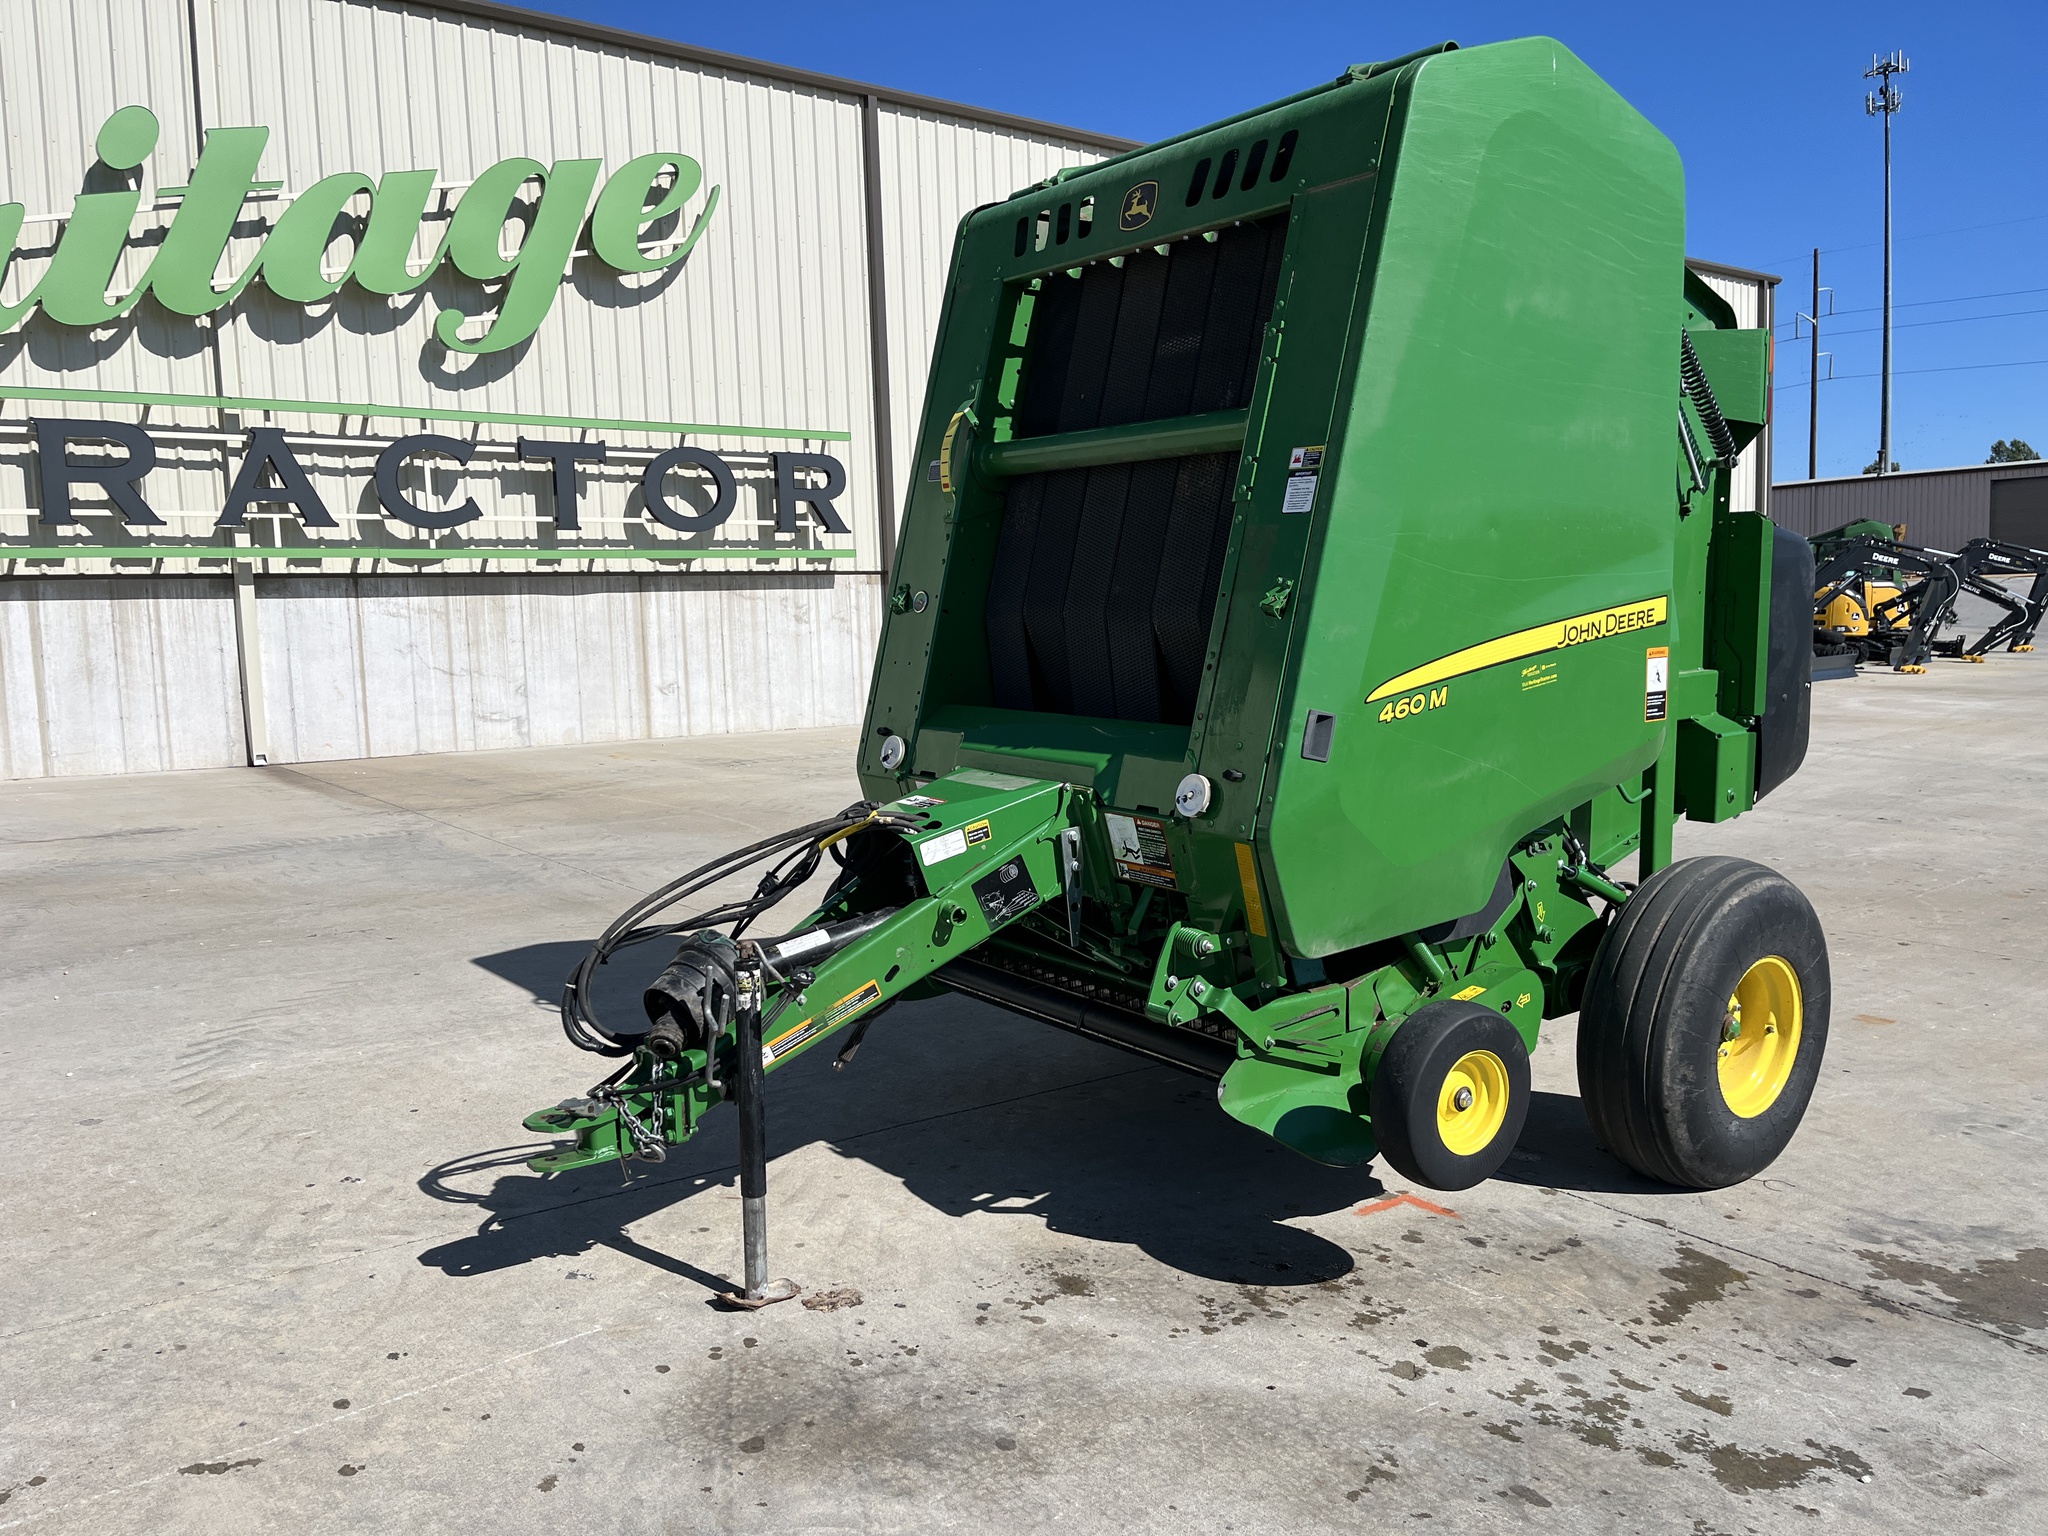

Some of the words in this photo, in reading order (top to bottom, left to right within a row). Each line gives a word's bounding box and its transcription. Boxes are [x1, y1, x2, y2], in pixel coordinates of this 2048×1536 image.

[1872, 552, 1900, 565] DEERE
[1988, 552, 2011, 564] DEERE
[1557, 620, 1601, 646] JOHN
[1605, 608, 1655, 633] DEERE
[1378, 692, 1426, 724] 460
[1428, 684, 1449, 711] M
